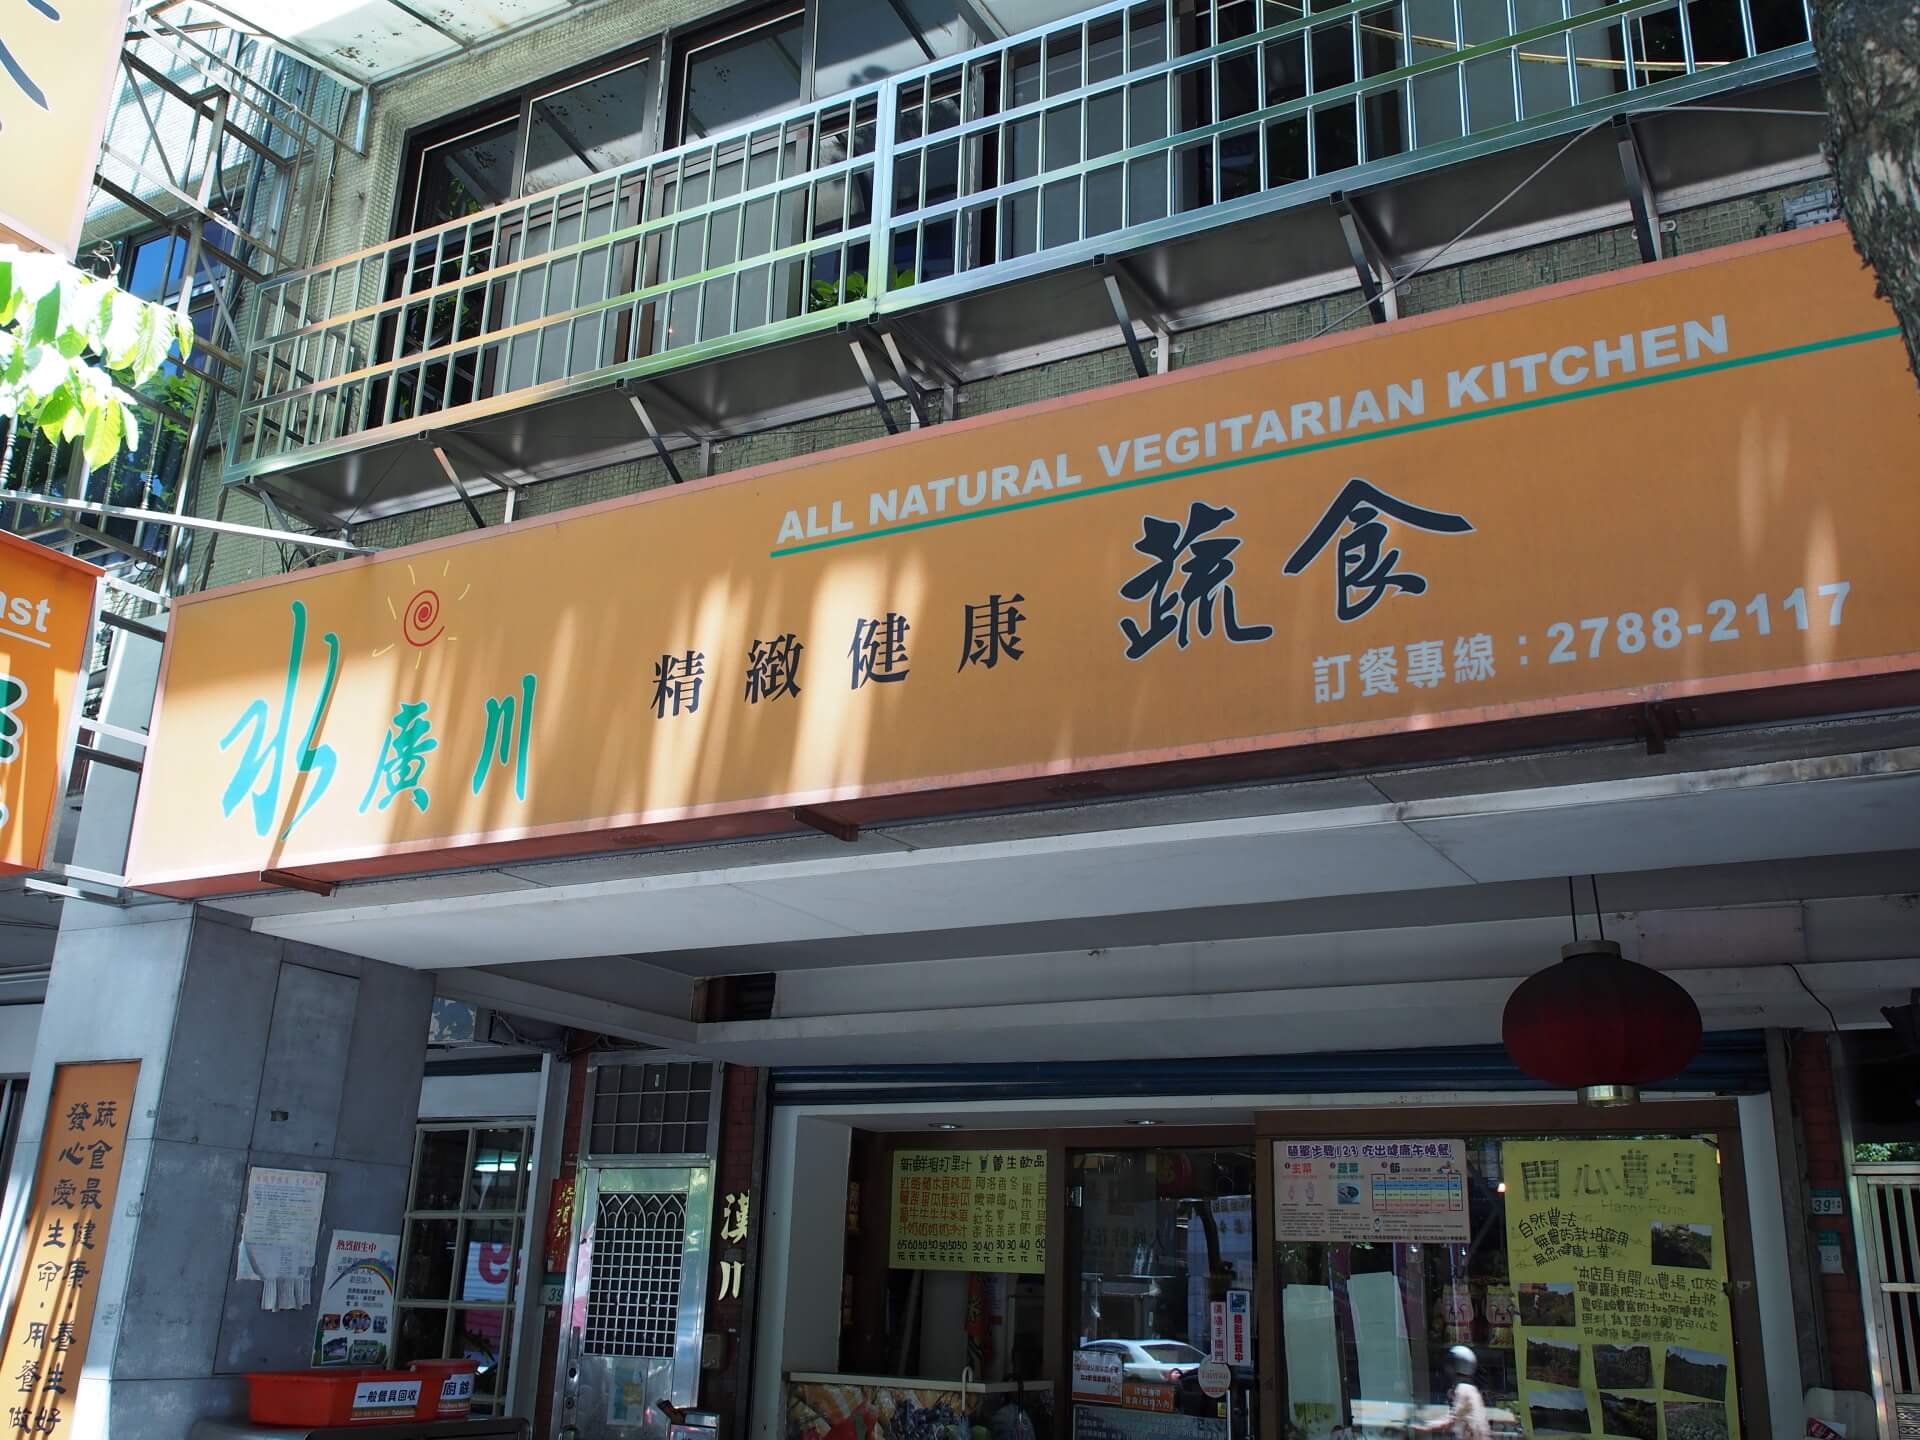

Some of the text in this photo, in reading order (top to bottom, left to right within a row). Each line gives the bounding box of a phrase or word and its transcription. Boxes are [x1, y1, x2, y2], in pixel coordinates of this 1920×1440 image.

[776, 315, 1728, 545] ALL NATURAL VEGITARIAN KITCHEN
[650, 477, 1478, 720] 精緻健康 蔬食
[1547, 581, 1852, 666] 2788-2117
[357, 1389, 418, 1404] 一般餐具回收
